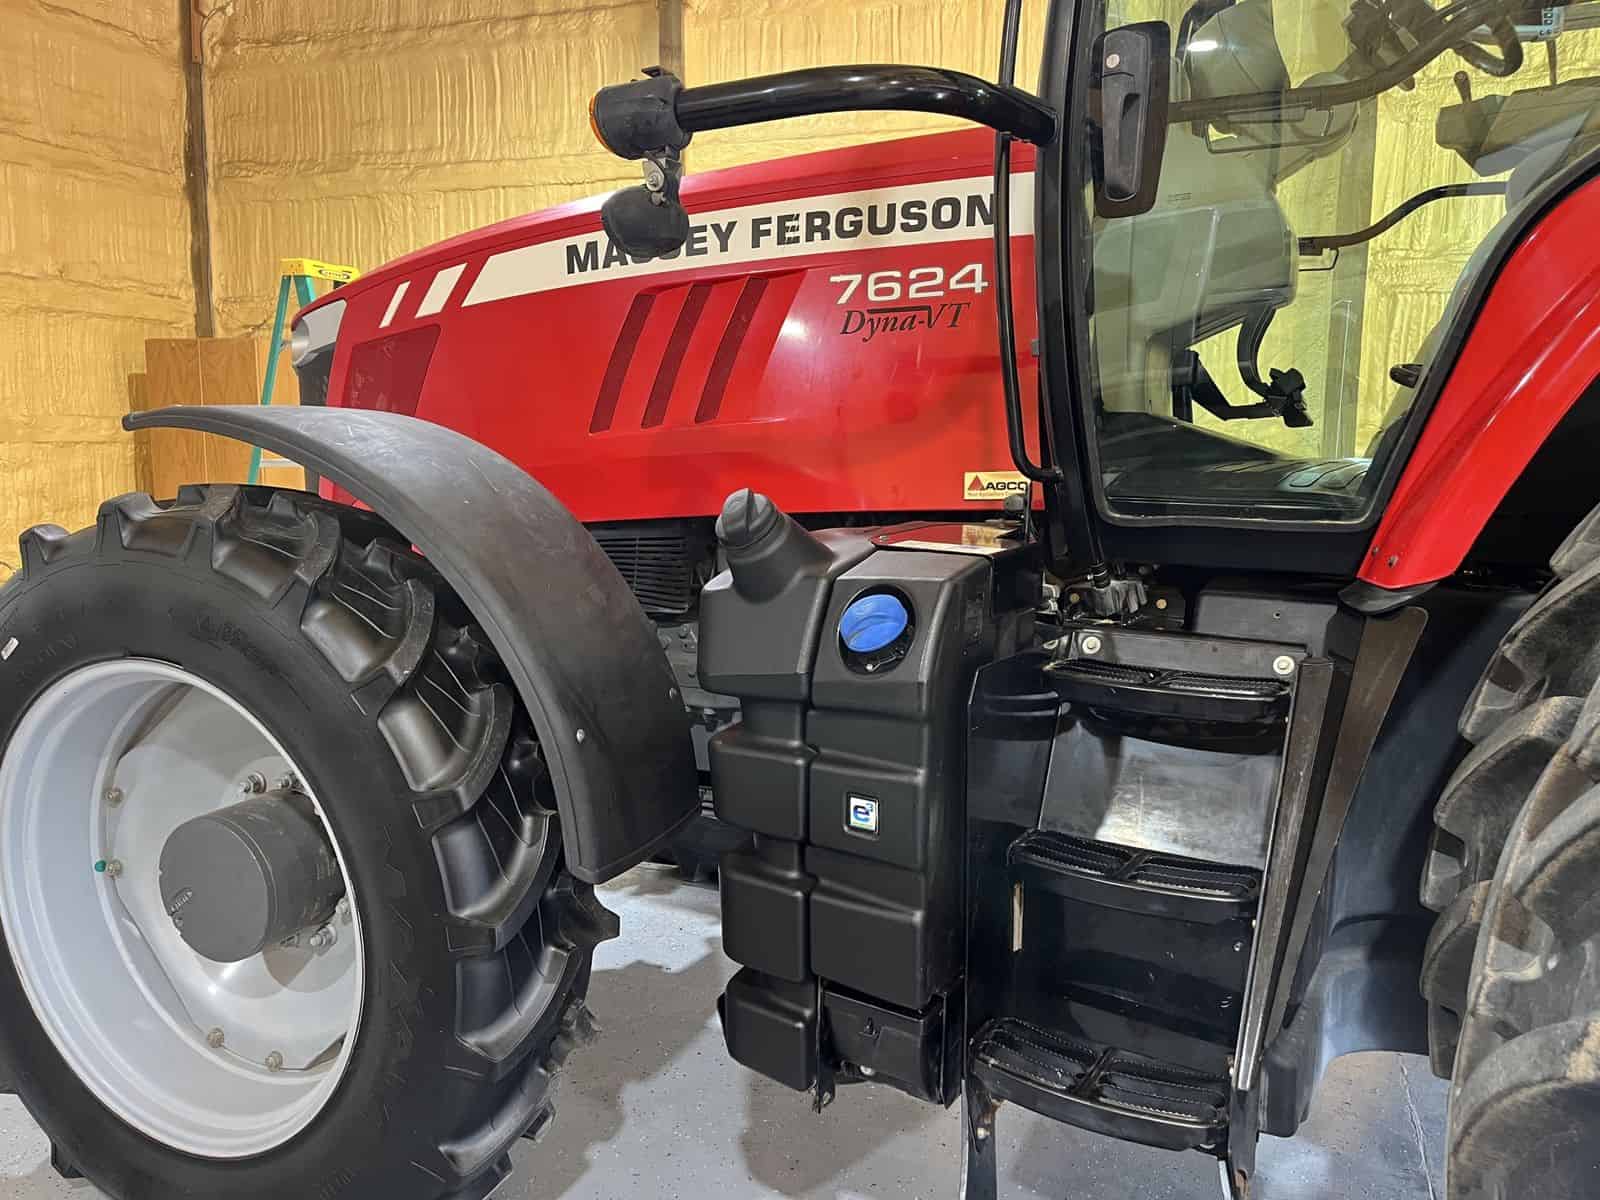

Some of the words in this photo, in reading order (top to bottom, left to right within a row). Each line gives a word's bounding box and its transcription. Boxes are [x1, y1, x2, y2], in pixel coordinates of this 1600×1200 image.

[566, 220, 738, 275] MAEY
[751, 193, 995, 249] FERGUSON
[829, 263, 989, 305] 7624
[840, 302, 971, 342] Dyna-VT
